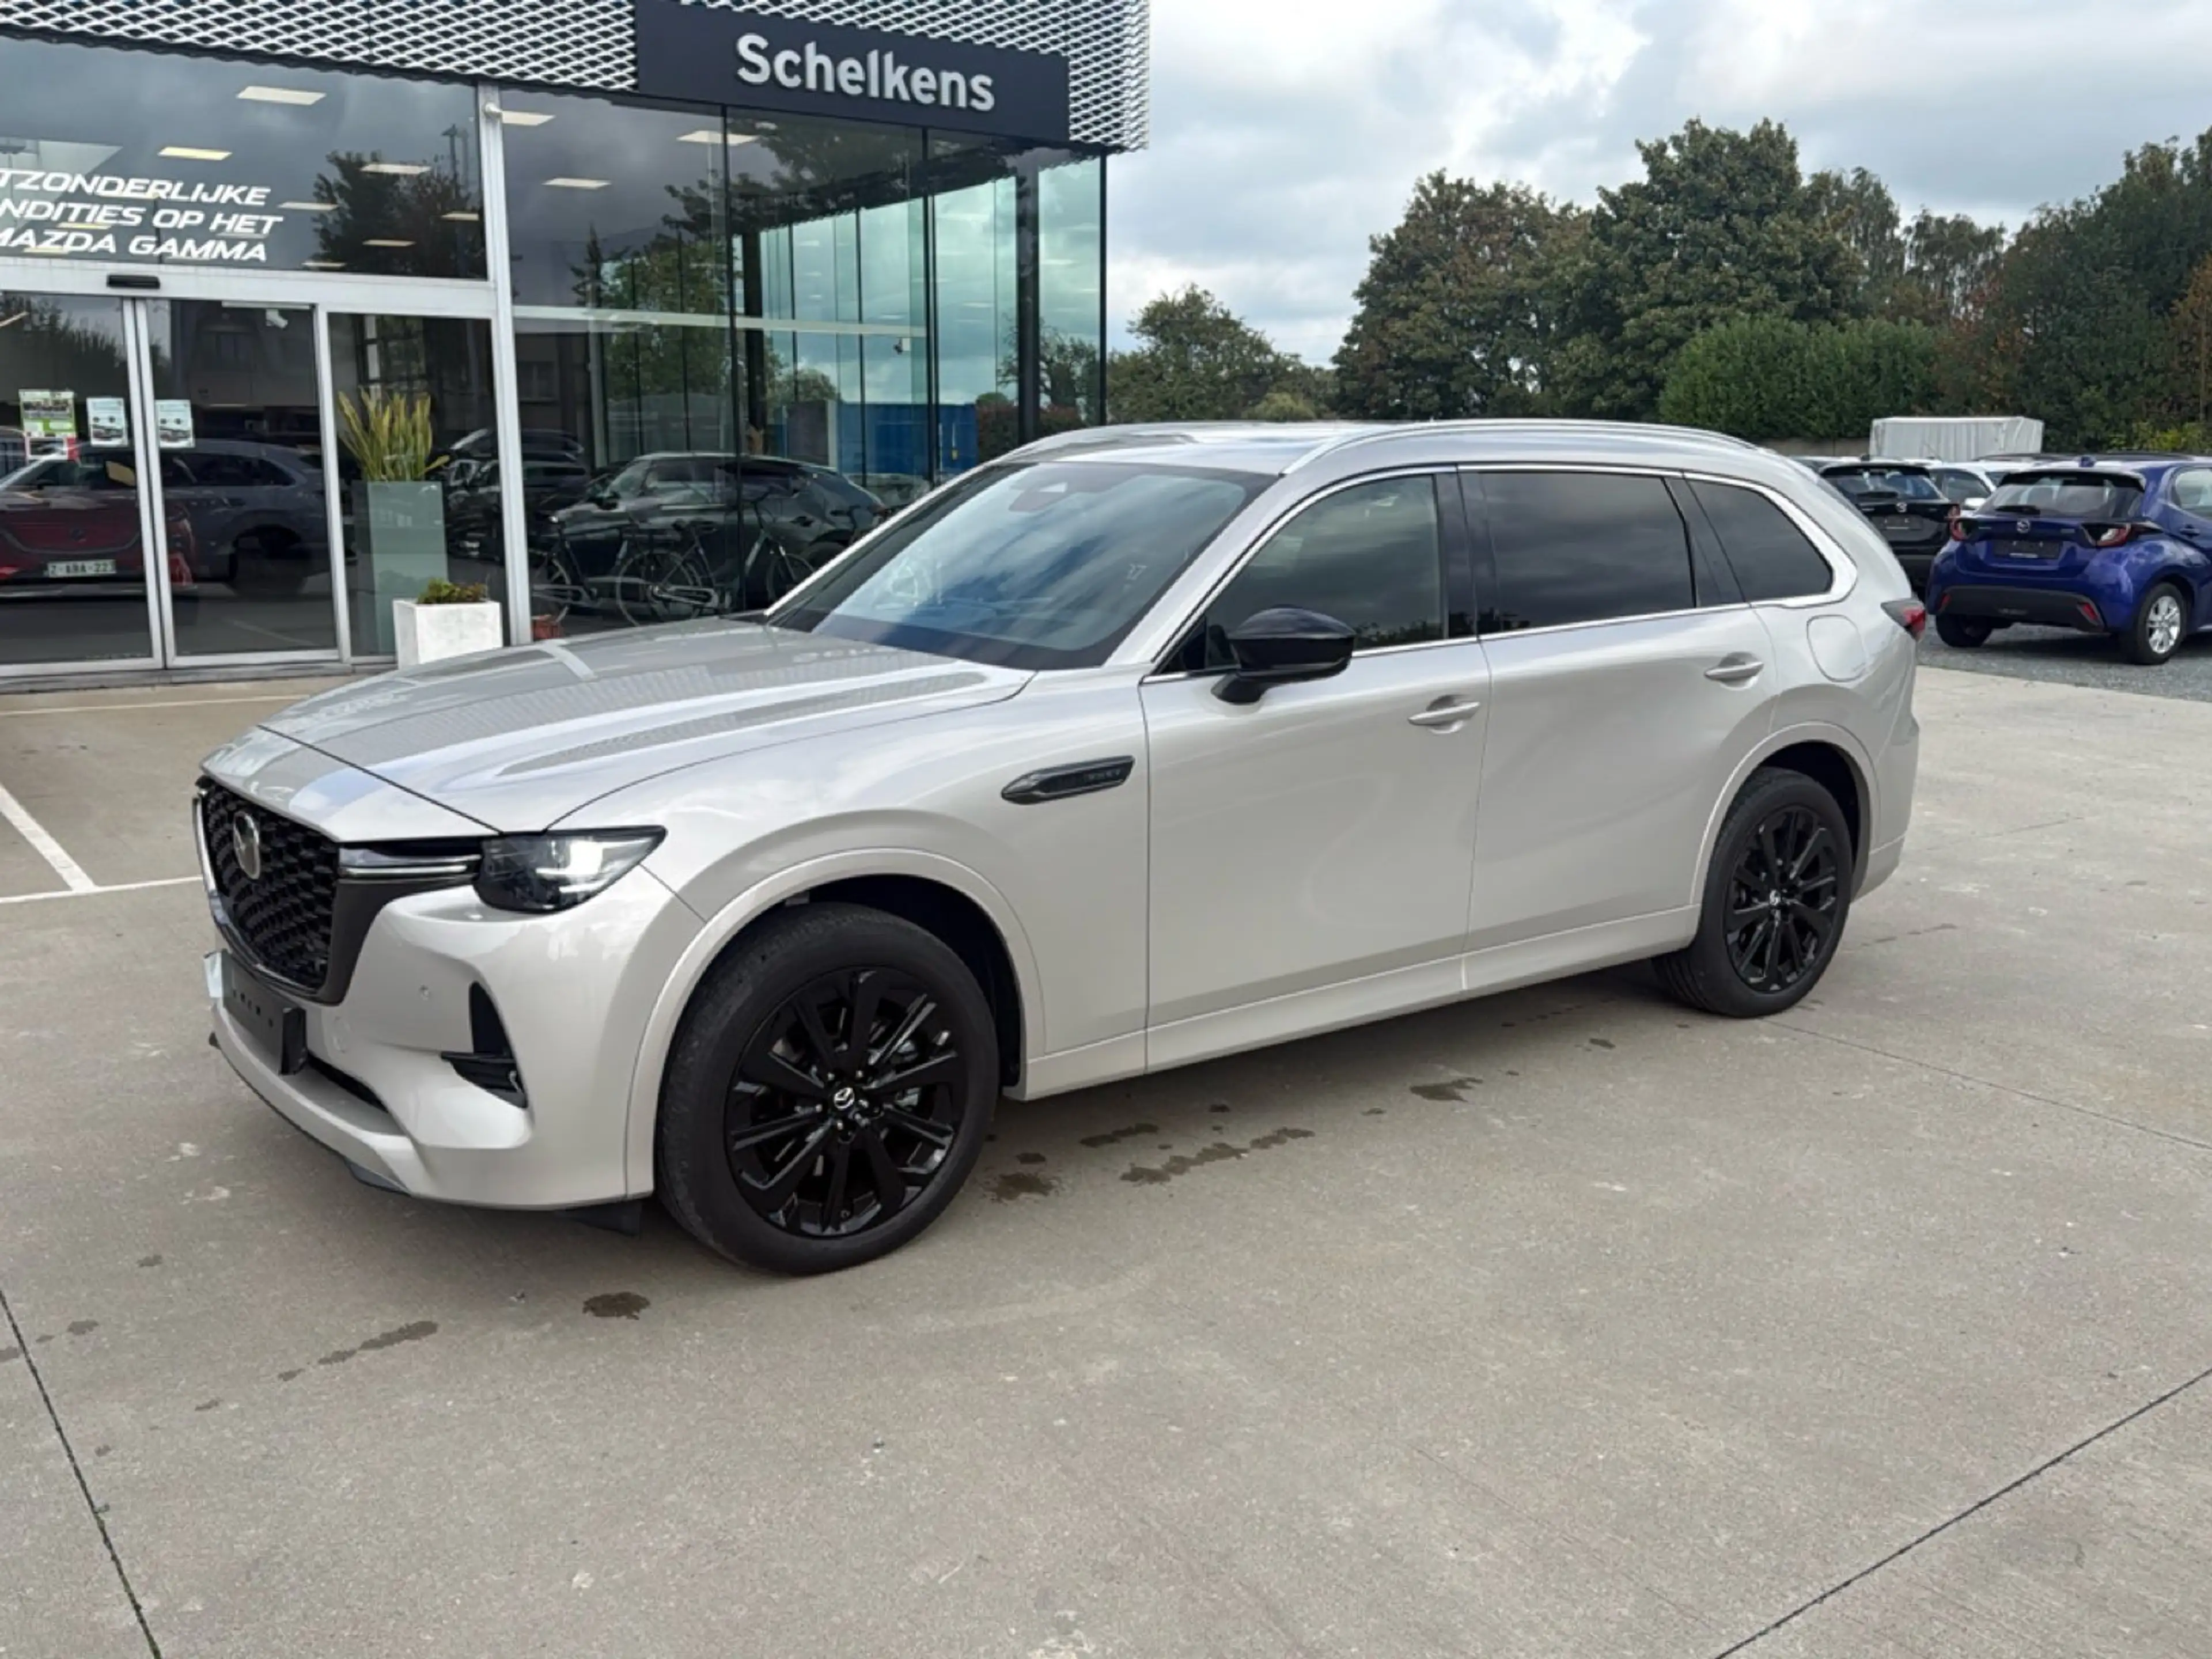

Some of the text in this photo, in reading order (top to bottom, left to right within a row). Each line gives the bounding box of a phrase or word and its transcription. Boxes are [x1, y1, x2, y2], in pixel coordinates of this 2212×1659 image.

[736, 33, 995, 111] Schelkens
[152, 209, 204, 230] OP
[209, 213, 283, 234] HET
[128, 235, 267, 262] GAMMA
